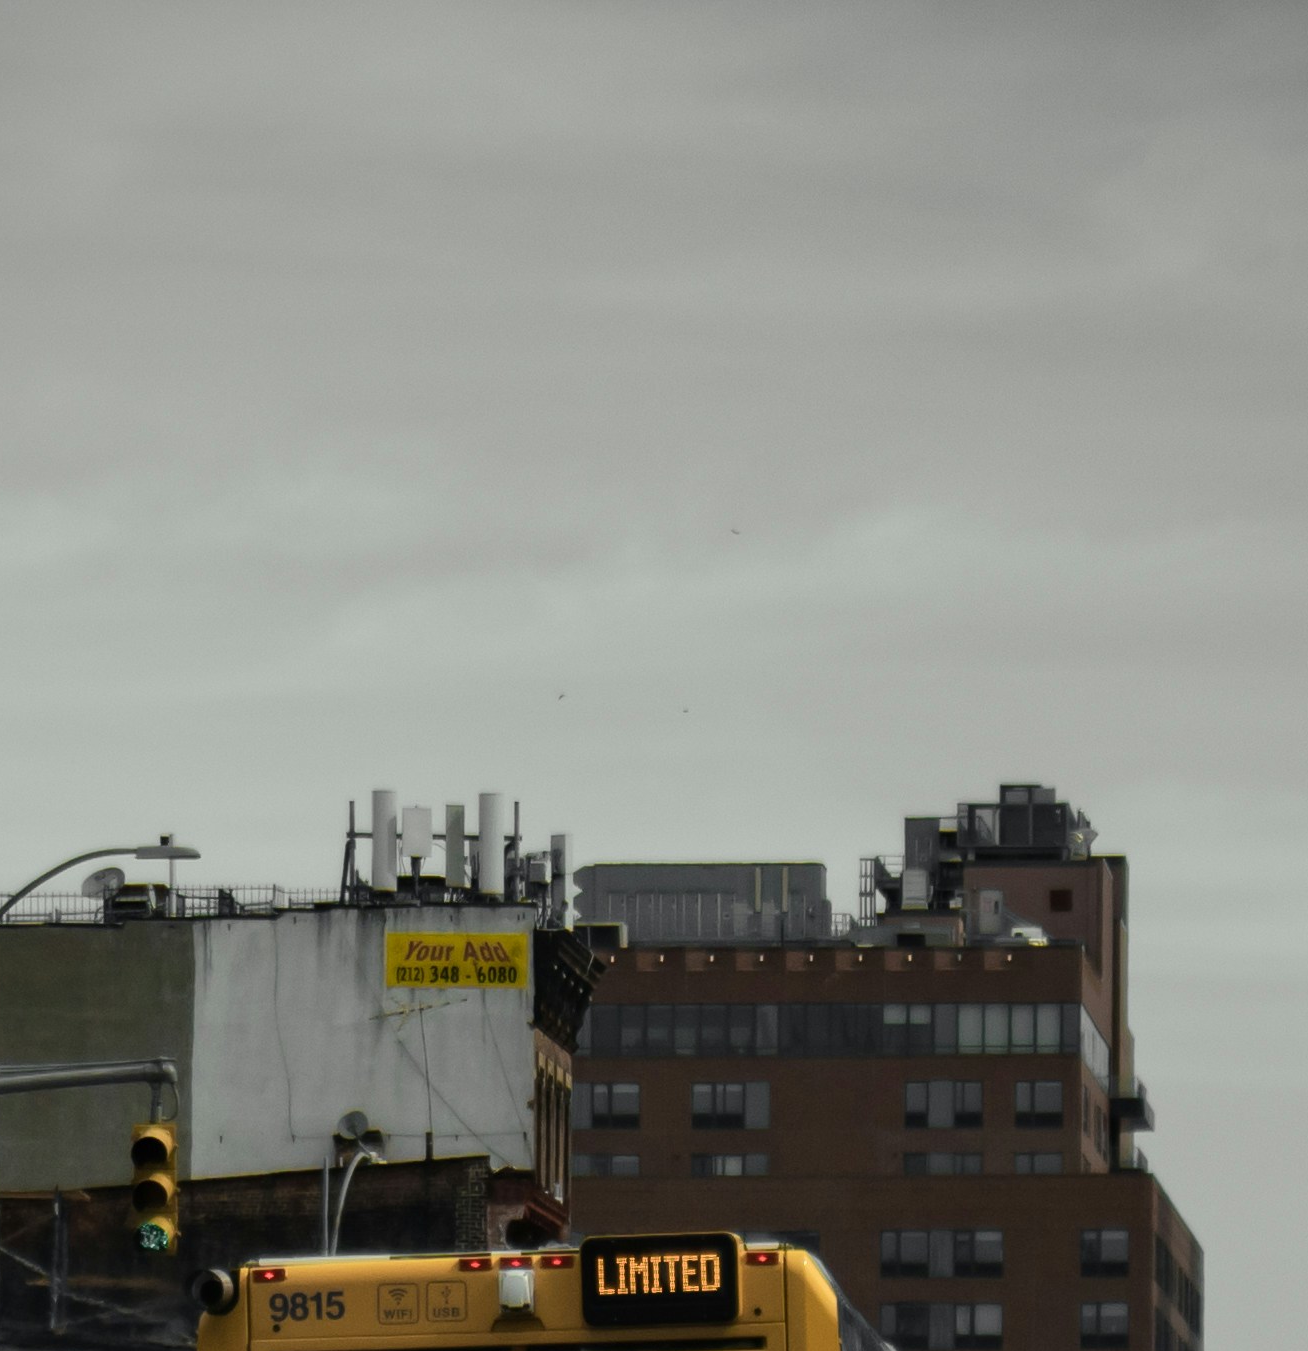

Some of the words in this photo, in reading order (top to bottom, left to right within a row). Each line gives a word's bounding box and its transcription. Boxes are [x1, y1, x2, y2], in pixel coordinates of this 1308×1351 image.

[404, 941, 454, 961] Your
[462, 941, 511, 961] Add
[396, 966, 425, 983] (212)
[430, 966, 459, 983] 348
[477, 966, 518, 983] 6080
[596, 1254, 721, 1296] LIMITED
[269, 1291, 346, 1322] 9815
[383, 1308, 413, 1320] WIFI
[433, 1307, 460, 1319] USB
